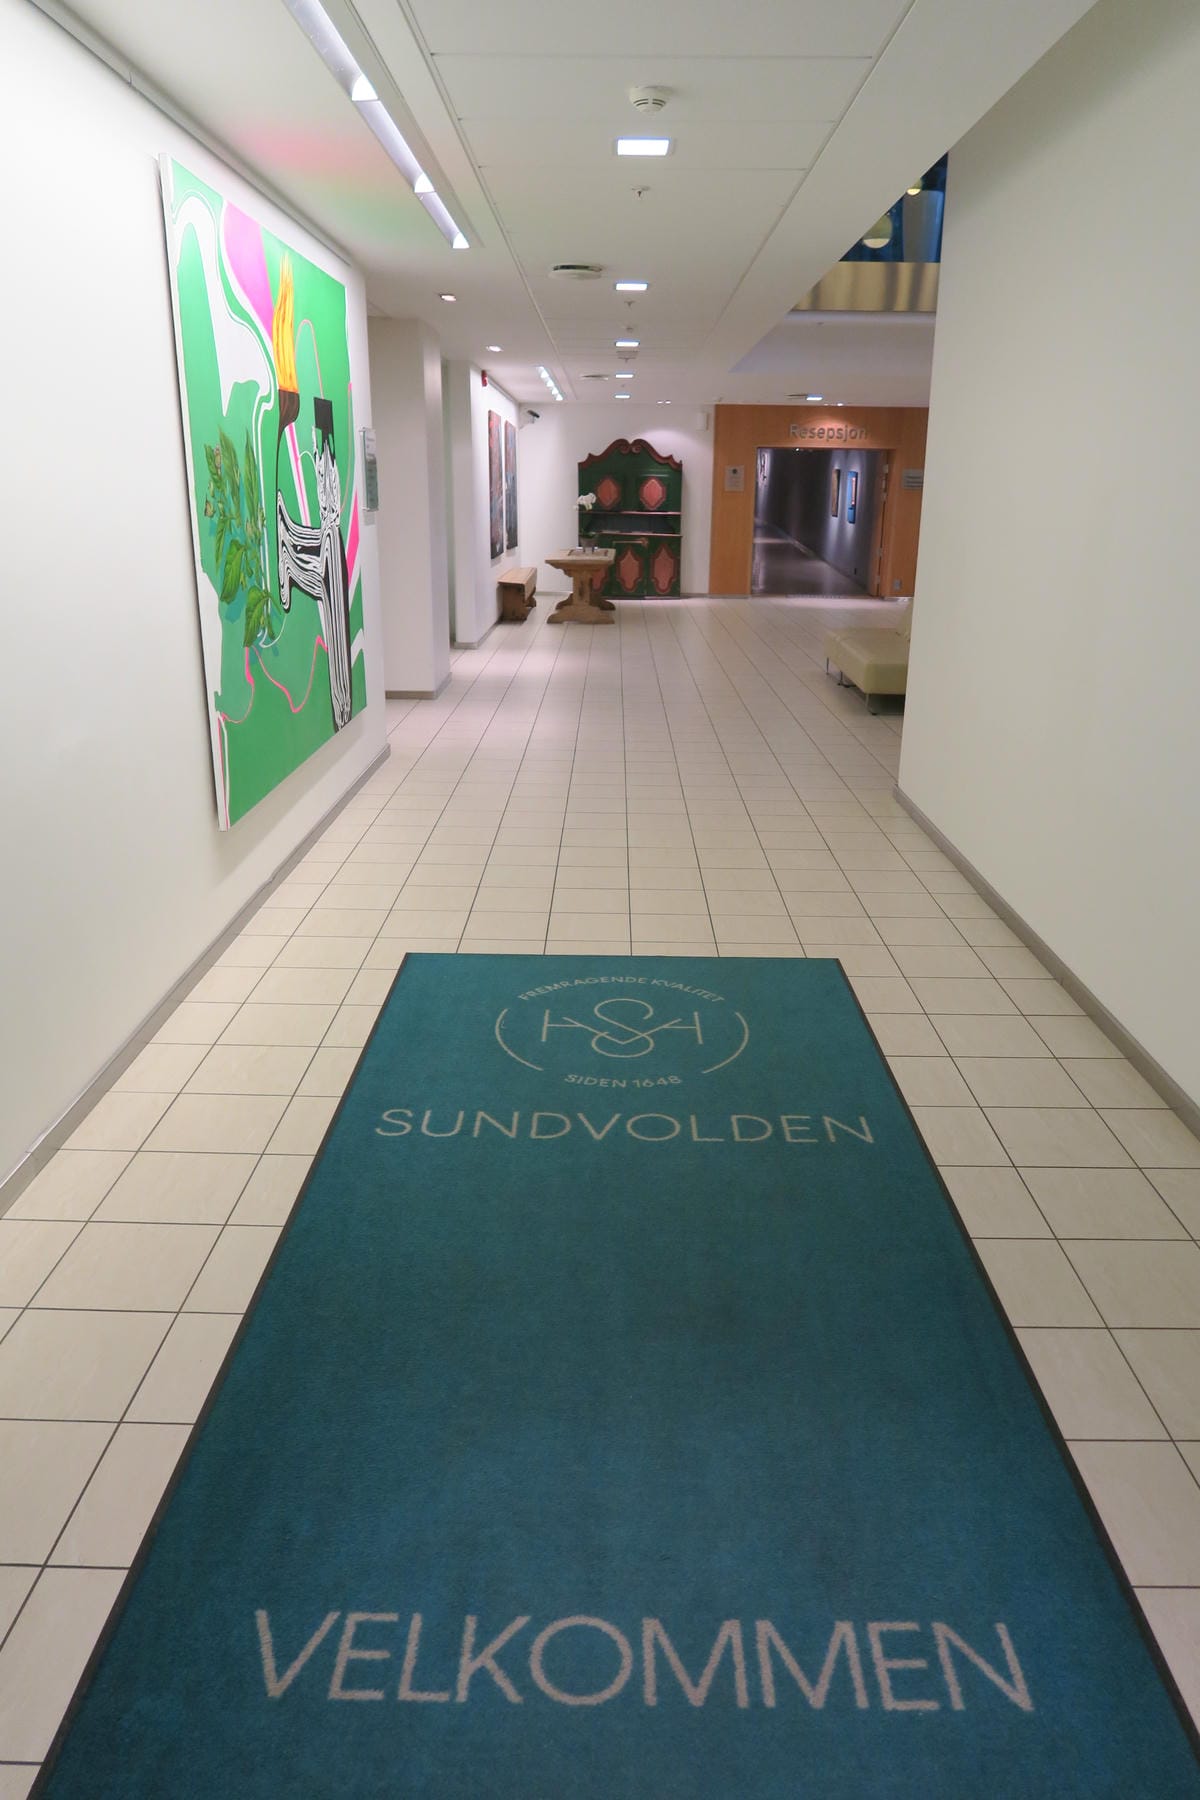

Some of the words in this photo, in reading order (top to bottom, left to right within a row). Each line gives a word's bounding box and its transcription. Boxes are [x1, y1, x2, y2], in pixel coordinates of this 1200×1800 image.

[789, 424, 868, 442] Resepsjon
[517, 976, 649, 1001] FREMRAGENDE
[651, 979, 725, 1002] KVALITET
[564, 1074, 627, 1088] SIDEN
[632, 1075, 682, 1088] 1648
[375, 1108, 874, 1144] SUNDVOLDEN
[255, 1608, 1035, 1713] VELKOMMEN
